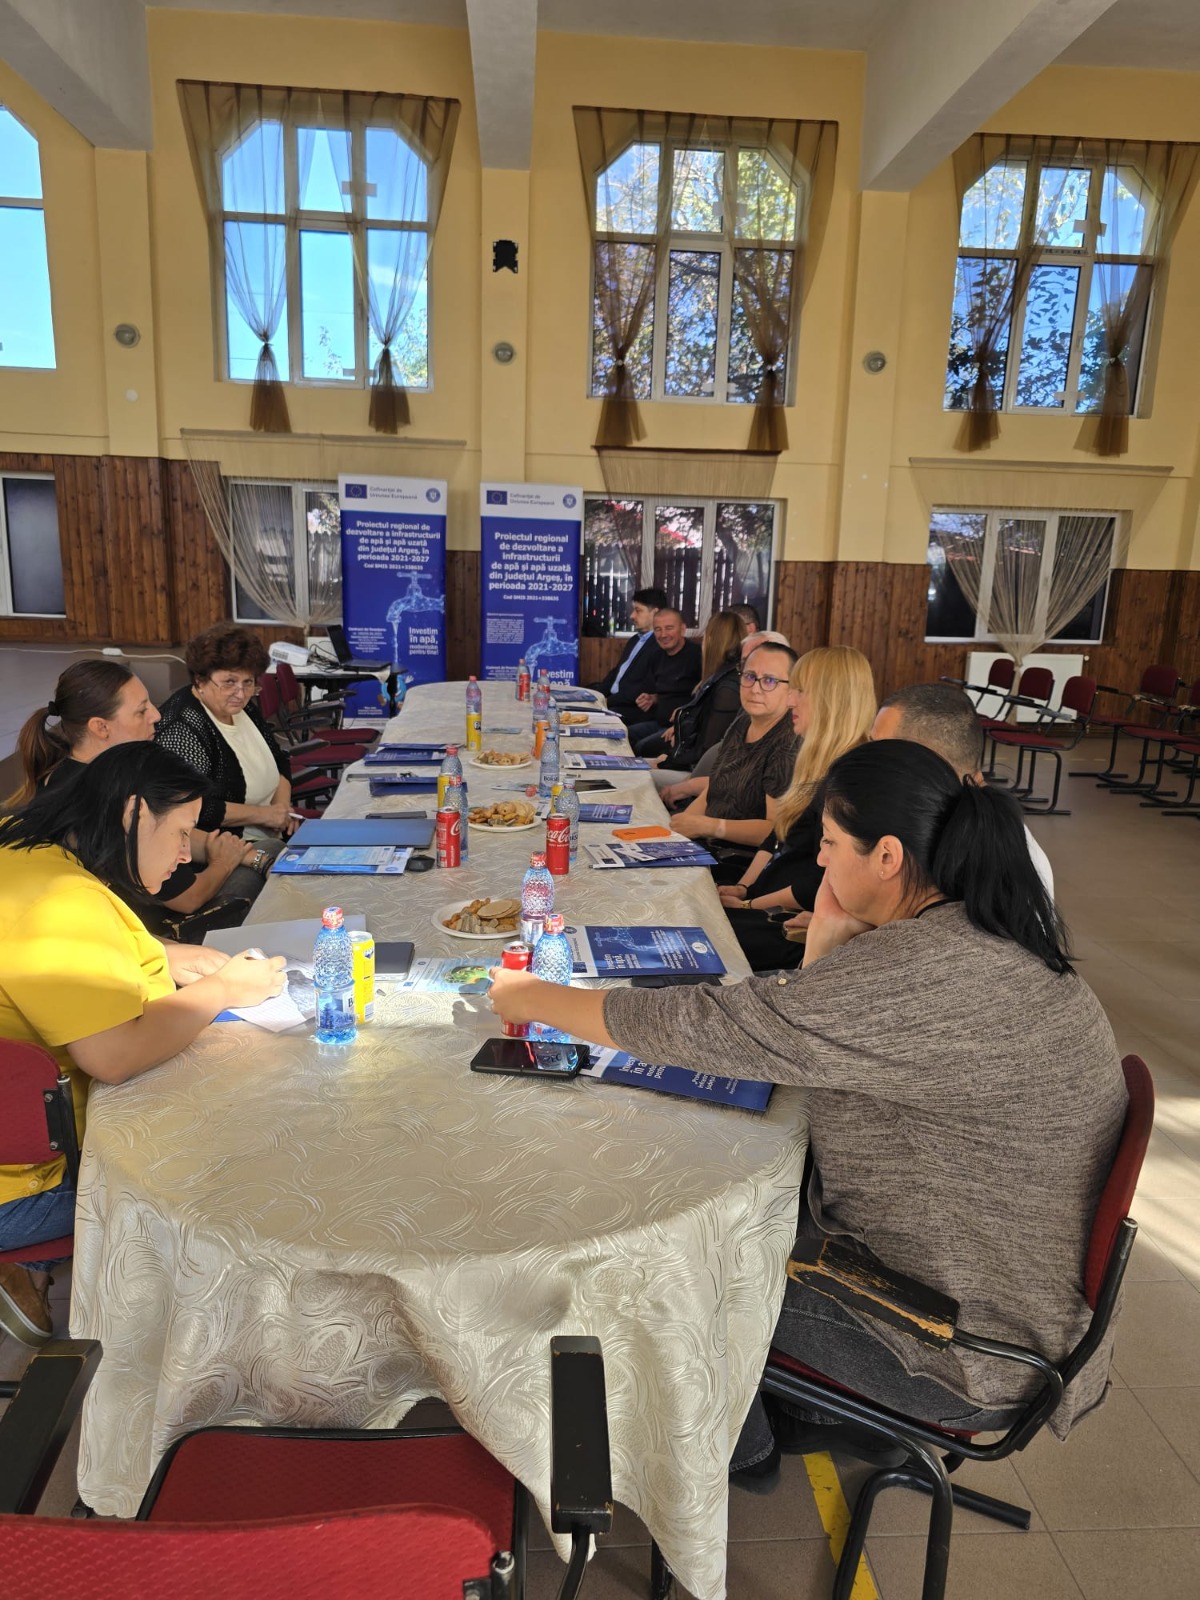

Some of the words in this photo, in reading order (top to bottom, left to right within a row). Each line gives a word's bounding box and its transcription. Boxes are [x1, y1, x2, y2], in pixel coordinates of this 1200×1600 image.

[356, 520, 389, 528] Proiectul
[390, 522, 420, 531] regional
[346, 528, 384, 536] dezvoltare
[391, 530, 440, 539] infrastructurii
[494, 532, 532, 541] Proiectul
[534, 534, 568, 543] regional
[370, 537, 384, 545] apă
[499, 542, 510, 550] de
[512, 543, 557, 552] dezvoltare
[357, 553, 389, 561] perioada
[391, 554, 429, 562] 2021-2027
[502, 552, 560, 562] infrastructurii
[504, 562, 520, 571] apă
[530, 563, 546, 572] apă
[548, 564, 571, 572] uzată
[565, 574, 573, 582] în
[489, 582, 526, 590] perioada
[528, 583, 573, 591] 2021-2027
[409, 627, 438, 635] Investim
[410, 635, 418, 643] în
[419, 636, 438, 644] apă,
[537, 669, 574, 679] Ivestim
